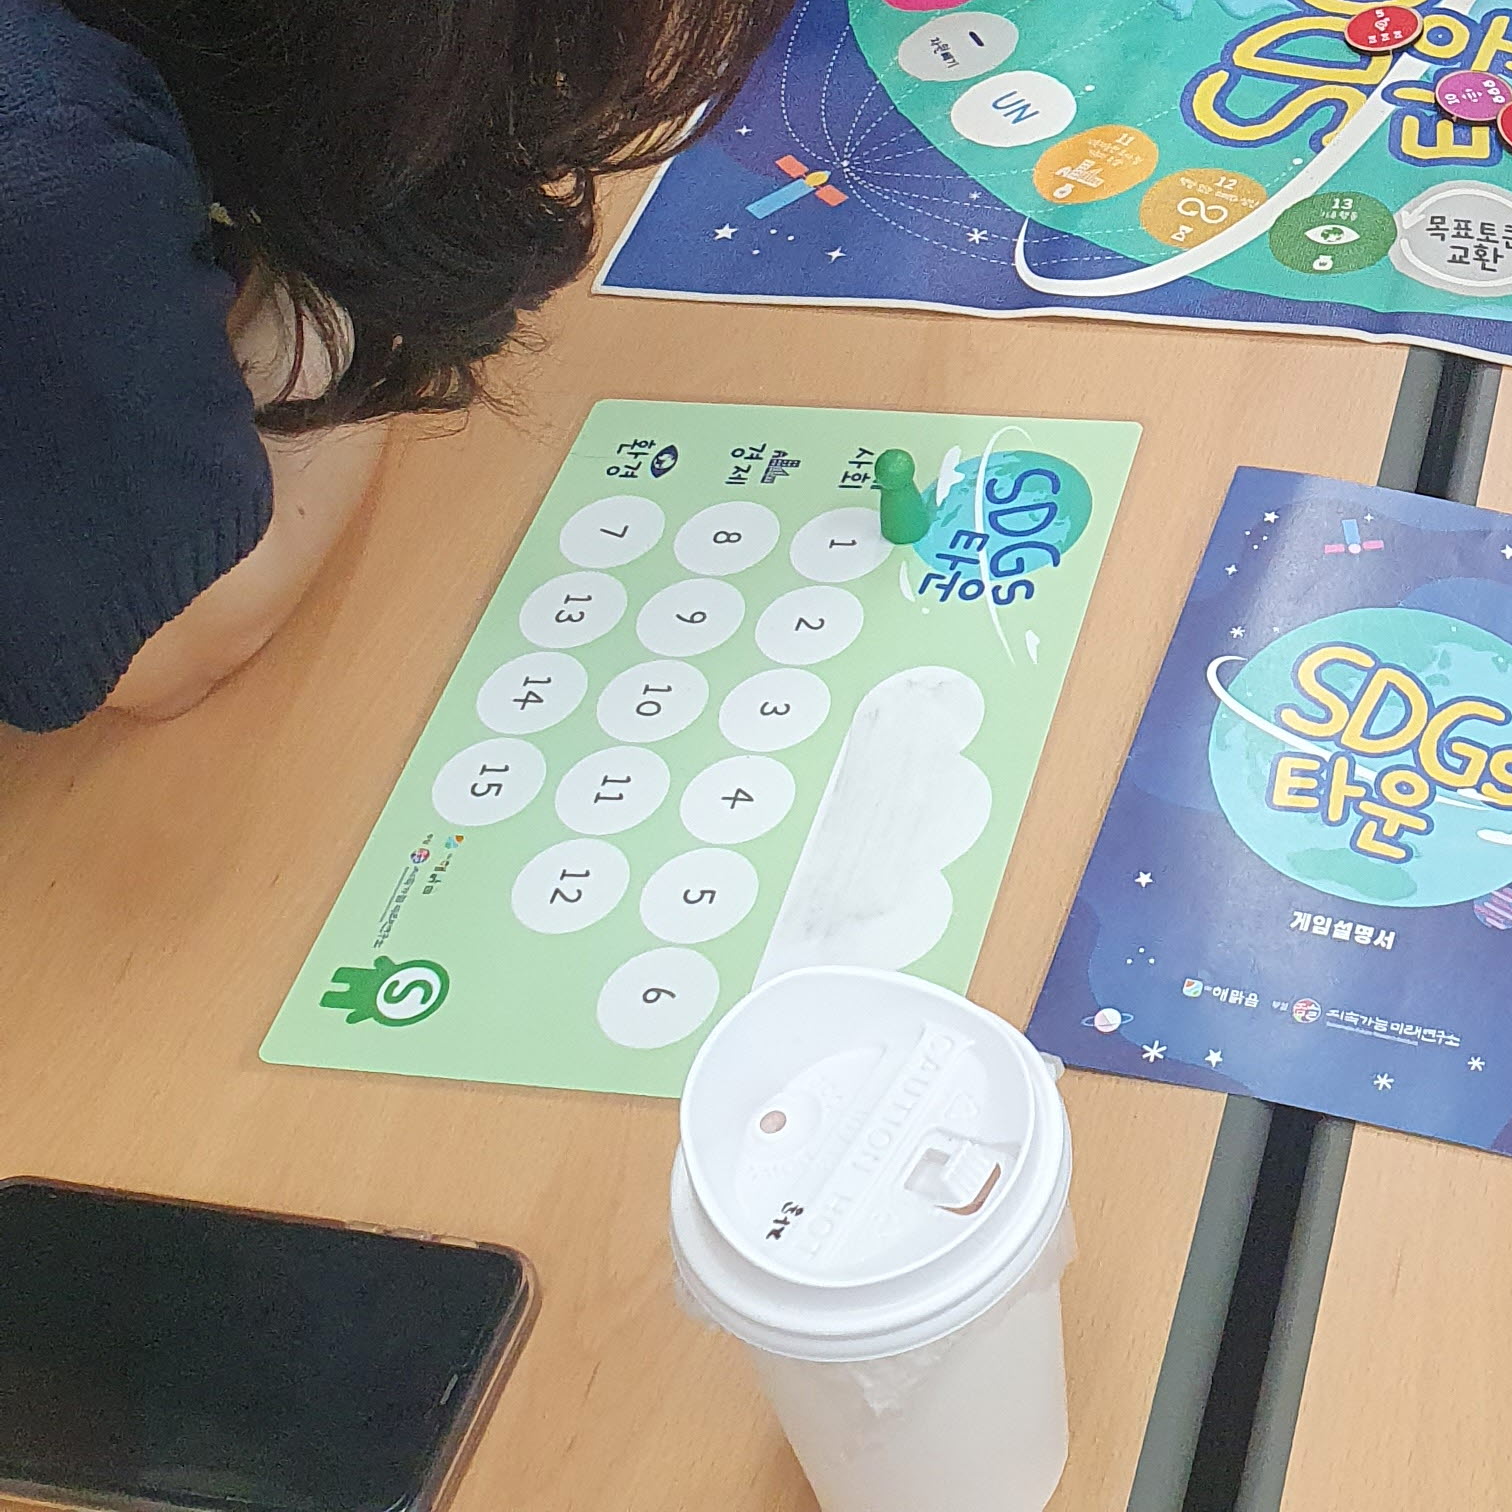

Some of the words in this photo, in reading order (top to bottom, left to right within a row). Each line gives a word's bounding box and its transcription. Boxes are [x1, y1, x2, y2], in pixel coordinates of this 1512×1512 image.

[991, 90, 1040, 125] UN
[1445, 93, 1460, 105] 10
[1214, 176, 1239, 191] 12
[1331, 197, 1354, 211] 13
[1446, 245, 1505, 273] 교환
[606, 439, 657, 480] 환경
[725, 443, 767, 485] 경제
[838, 447, 877, 489] 사회
[600, 525, 629, 539] 7
[712, 530, 742, 544] 8
[829, 539, 857, 549] 1
[985, 468, 1061, 606] SDGs
[918, 529, 990, 603] 타운
[554, 594, 593, 625] 13
[676, 611, 707, 624] 9
[795, 617, 825, 631] 2
[513, 676, 552, 710] 14
[635, 684, 672, 717] 10
[760, 701, 791, 716] 3
[470, 764, 509, 797] 15
[593, 775, 631, 804] 11
[721, 788, 754, 809] 4
[1266, 752, 1435, 864] 타운
[549, 869, 590, 904] 12
[683, 889, 716, 905] 5
[1290, 910, 1397, 950] 게임설명서
[642, 987, 676, 1004] 6
